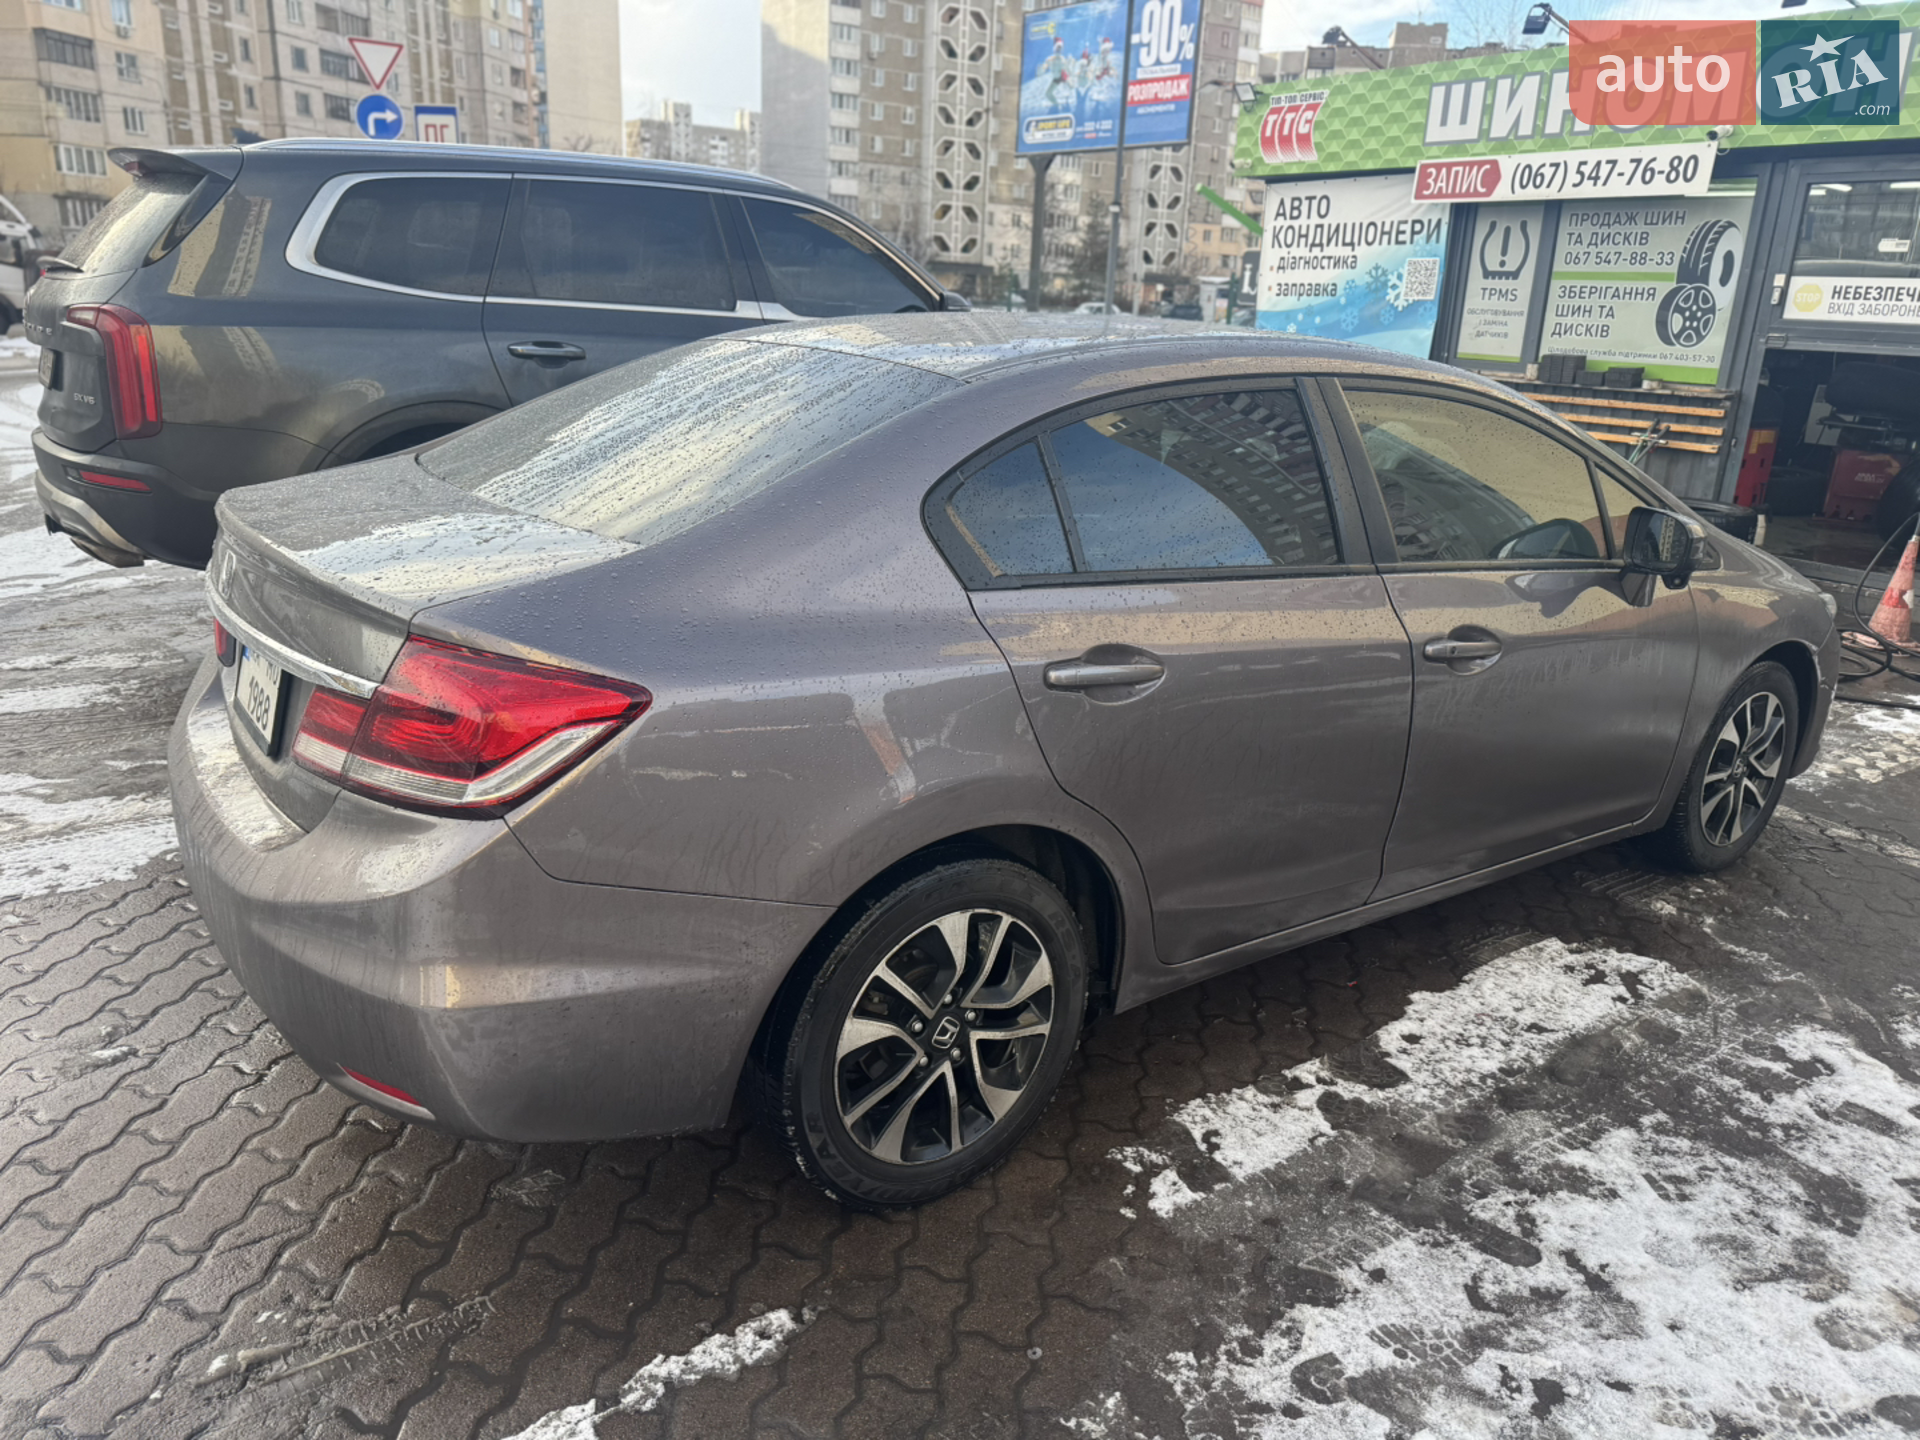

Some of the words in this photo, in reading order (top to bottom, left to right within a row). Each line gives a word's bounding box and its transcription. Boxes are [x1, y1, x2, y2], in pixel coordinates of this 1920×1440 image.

[1130, 0, 1195, 66] -90%
[1127, 78, 1189, 102] РОЗПРОДАЖ
[1422, 164, 1491, 195] ЗАПИС
[1511, 160, 1568, 195] (067)
[1571, 154, 1700, 188] 547-76-80
[1273, 194, 1331, 222] АВТО
[1568, 211, 1640, 230] ПРОДАЖ
[1643, 210, 1687, 227] ШИН
[1271, 217, 1443, 253] КОНДИЦІОНЕРИ
[1566, 231, 1583, 247] ТА
[1587, 231, 1650, 249] ДИСКІВ
[1276, 250, 1358, 274] діагностика
[1564, 251, 1591, 267] 067
[1594, 251, 1675, 267] 547-88-33
[1275, 281, 1338, 301] заправка
[1480, 287, 1519, 302] TPMS
[1557, 285, 1657, 302] ЗБЕРІГАННЯ
[1795, 292, 1820, 304] STOP
[1554, 304, 1593, 319] ШИН
[1597, 305, 1616, 320] ТА
[1827, 303, 1854, 316] ВХІД
[1550, 322, 1610, 339] ДИСКІВ
[1659, 353, 1673, 361] 067
[1674, 354, 1716, 364] 403-57-30
[246, 675, 271, 731] 1988
